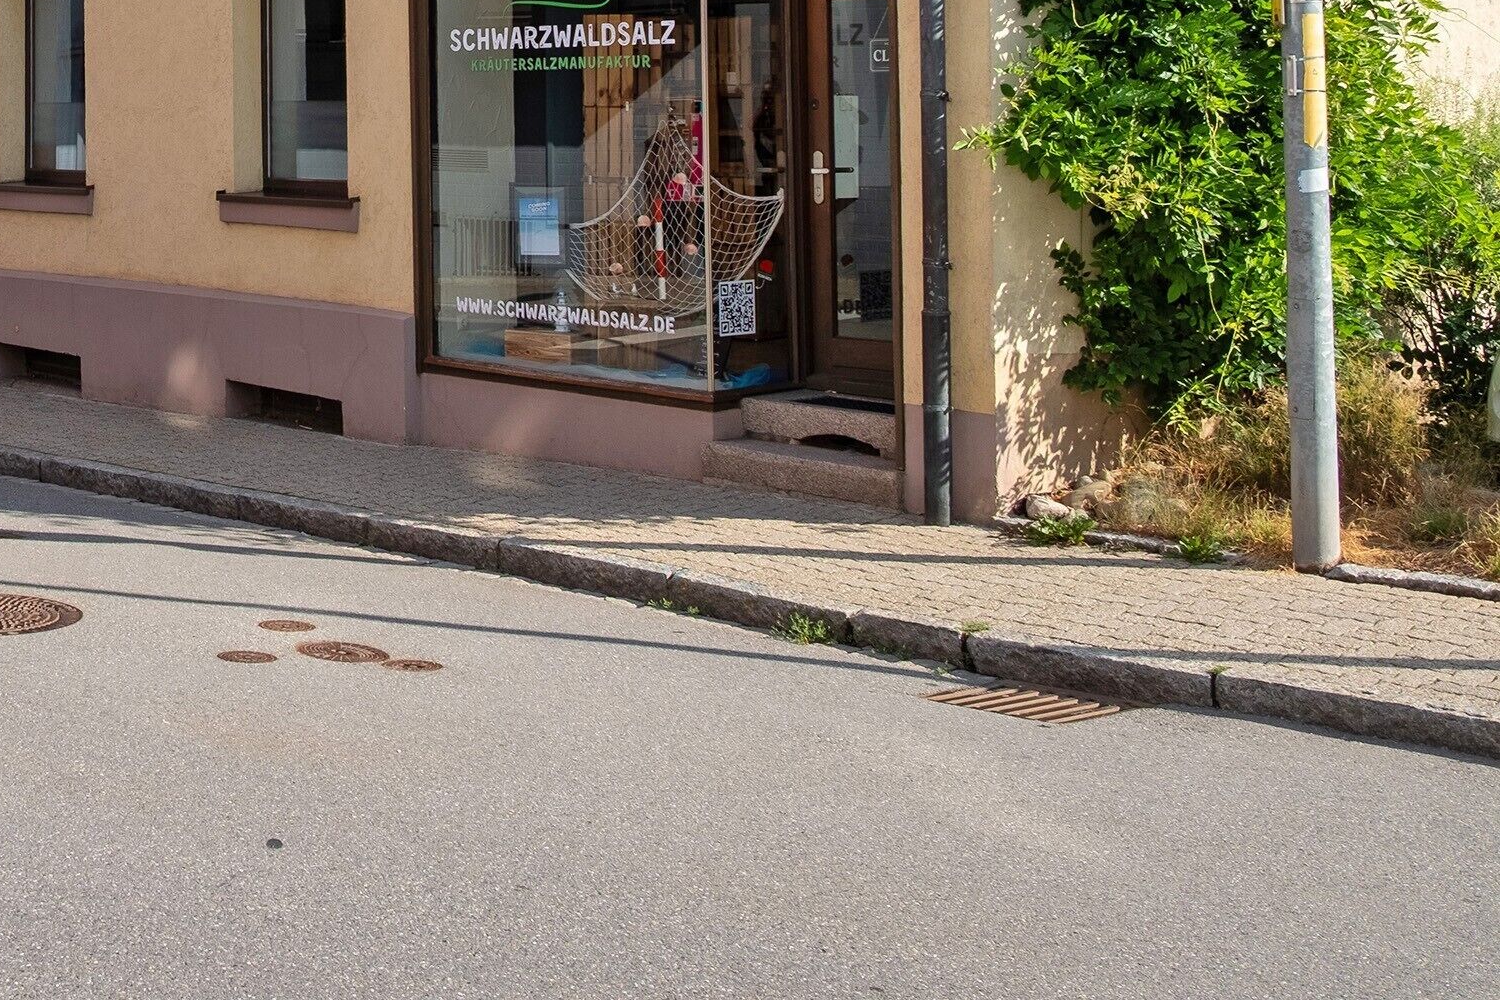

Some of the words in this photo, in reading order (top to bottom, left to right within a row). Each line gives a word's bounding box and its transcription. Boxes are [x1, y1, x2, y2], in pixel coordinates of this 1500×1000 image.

[450, 20, 676, 51] SCHWARZWALDSALZ
[471, 54, 651, 72] KRÄUTERSALZMANUFAKTUR
[456, 296, 676, 334] WWW.SCHWARZWALDSALZ.DE
